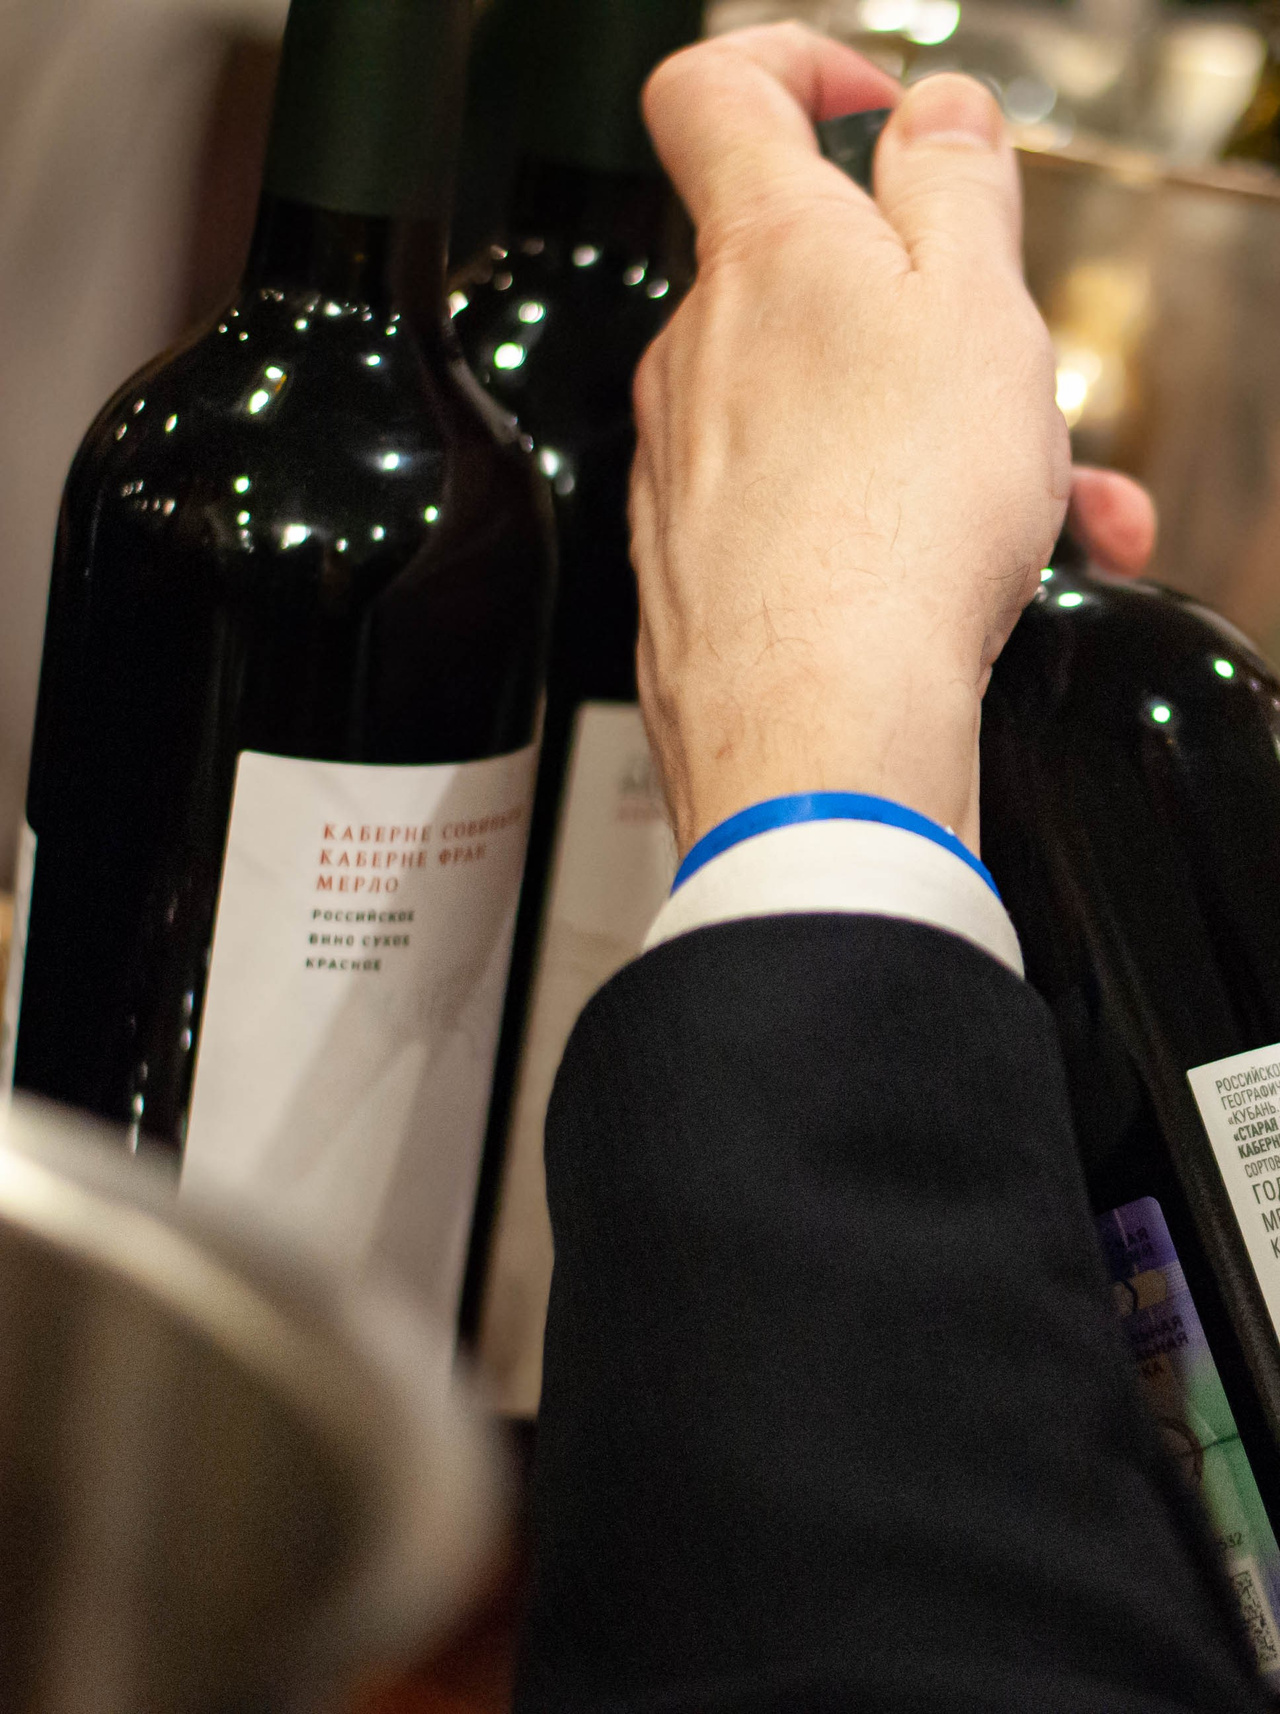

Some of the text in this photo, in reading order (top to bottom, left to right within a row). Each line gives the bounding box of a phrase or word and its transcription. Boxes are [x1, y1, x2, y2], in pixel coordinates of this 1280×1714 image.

[323, 823, 432, 844] КАБЕРНЕ
[319, 848, 427, 868] КАБЕРНЕ
[316, 874, 400, 893] МЕРЛО
[311, 908, 415, 922] РОССИЙСКОЕ
[308, 932, 411, 947] ВИНО СУХОЕ
[305, 957, 382, 971] КРАСНОЕ
[1227, 1101, 1279, 1125] «КУБАНЬ.
[1232, 1119, 1279, 1142] «СТАРАЯ
